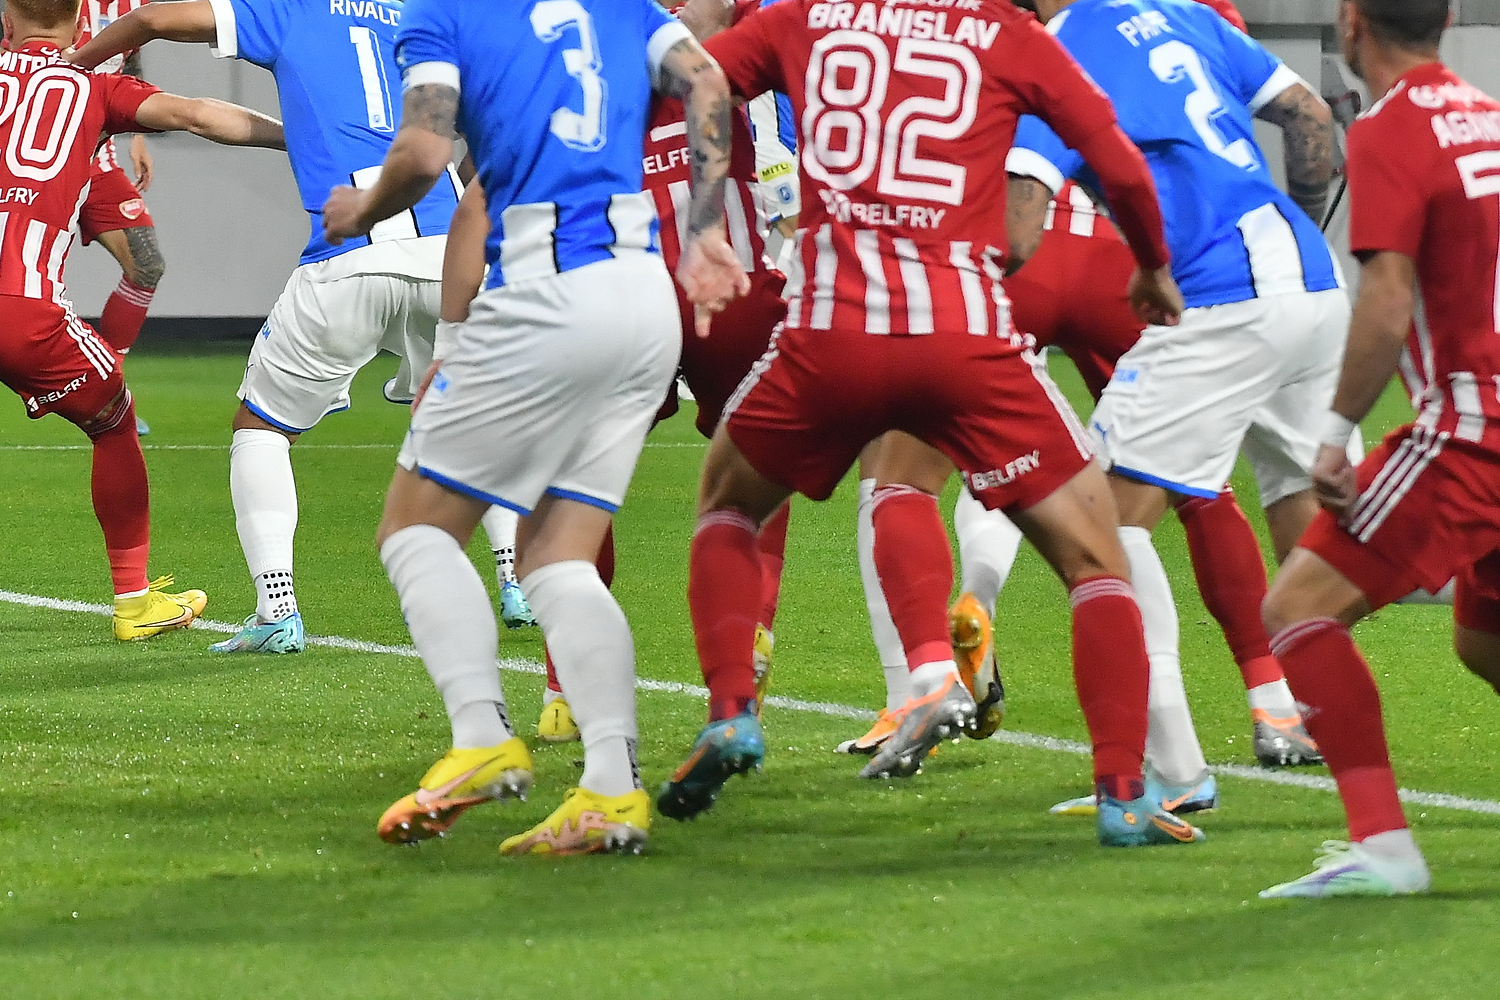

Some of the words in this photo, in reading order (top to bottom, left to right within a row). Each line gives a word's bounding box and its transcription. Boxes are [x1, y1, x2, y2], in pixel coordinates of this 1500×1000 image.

[807, 2, 1002, 50] BRANISLAV
[802, 29, 983, 206] 82
[1148, 39, 1261, 172] 2
[851, 202, 946, 230] BELFRY
[38, 372, 89, 404] BELFRY
[971, 449, 1040, 491] BELFRY
